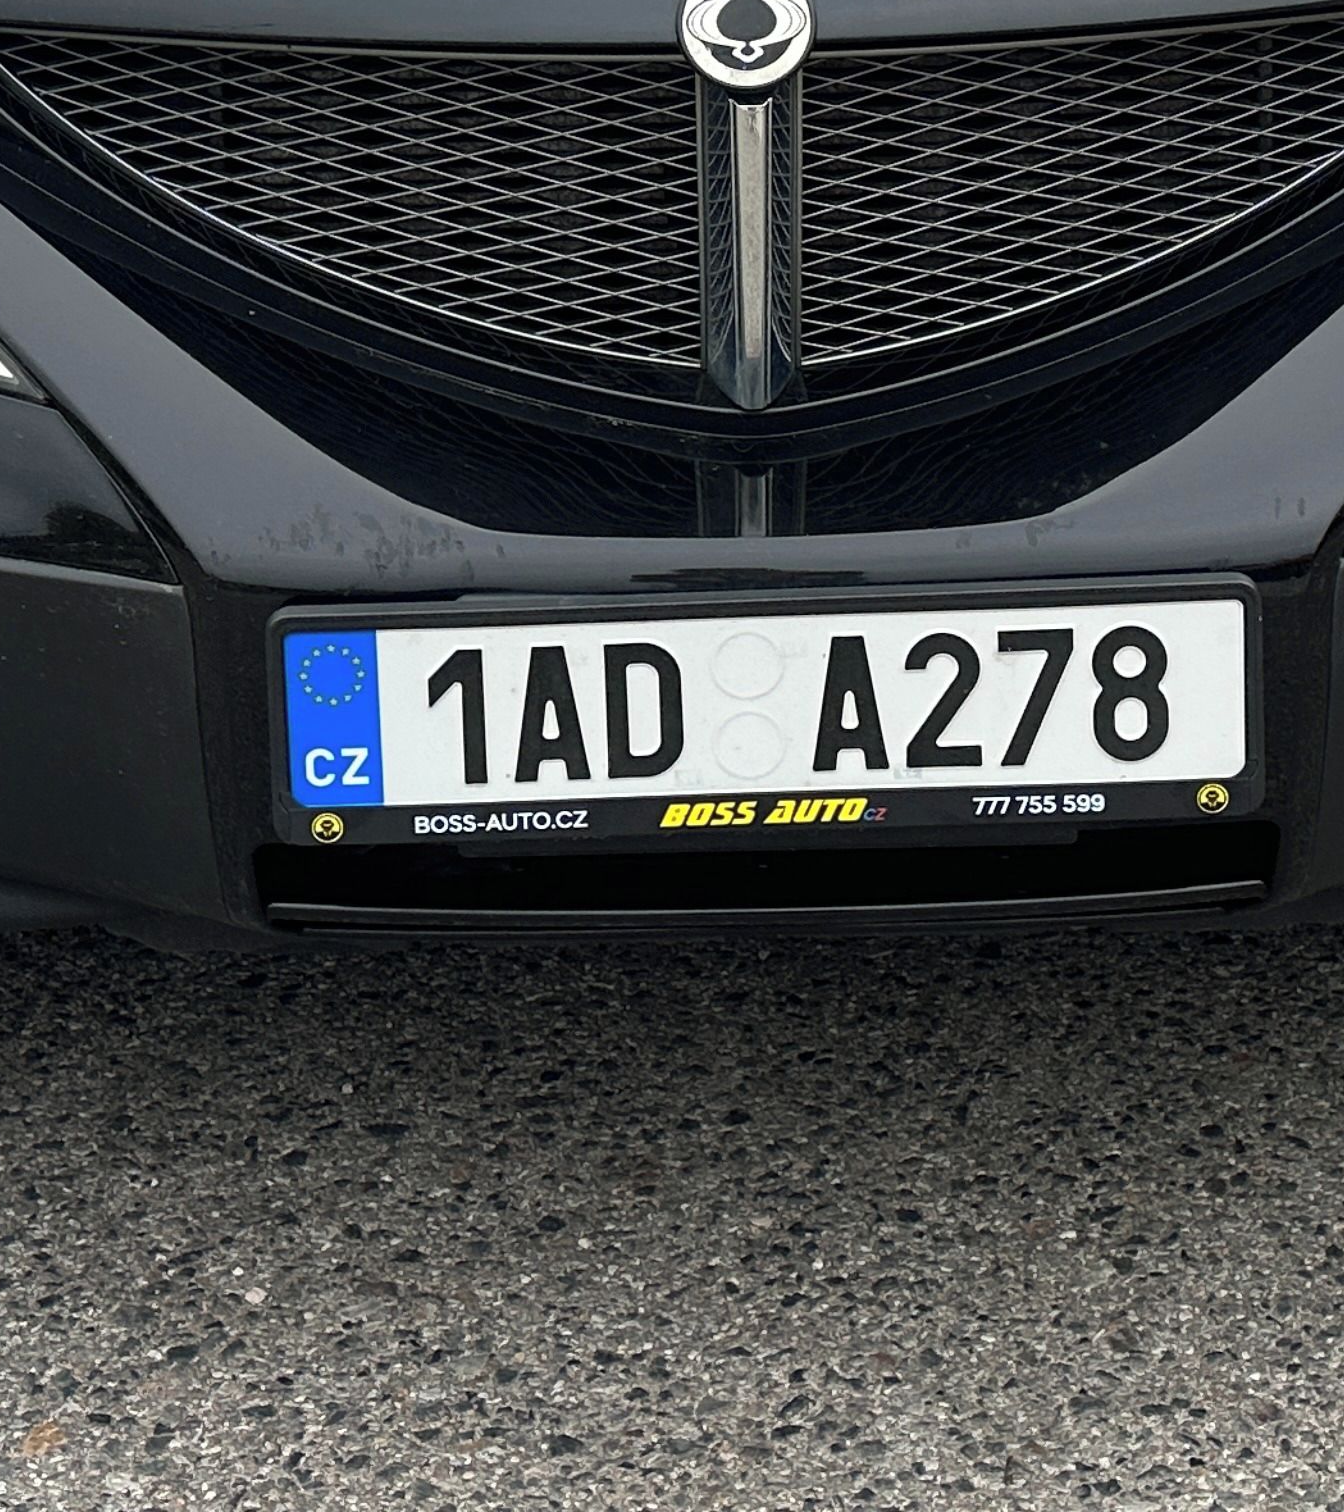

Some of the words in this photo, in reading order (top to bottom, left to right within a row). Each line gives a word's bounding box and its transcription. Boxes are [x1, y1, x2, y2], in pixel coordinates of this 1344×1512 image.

[427, 642, 685, 785] 1AD
[812, 624, 1171, 772] A278
[304, 746, 371, 788] CZ
[659, 801, 757, 828] BOSS
[763, 797, 869, 825] AUTO
[972, 796, 1010, 816] 777
[1015, 795, 1057, 815] 755
[1062, 793, 1106, 813] 599
[414, 810, 589, 834] BOSS-AUTO.CZ
